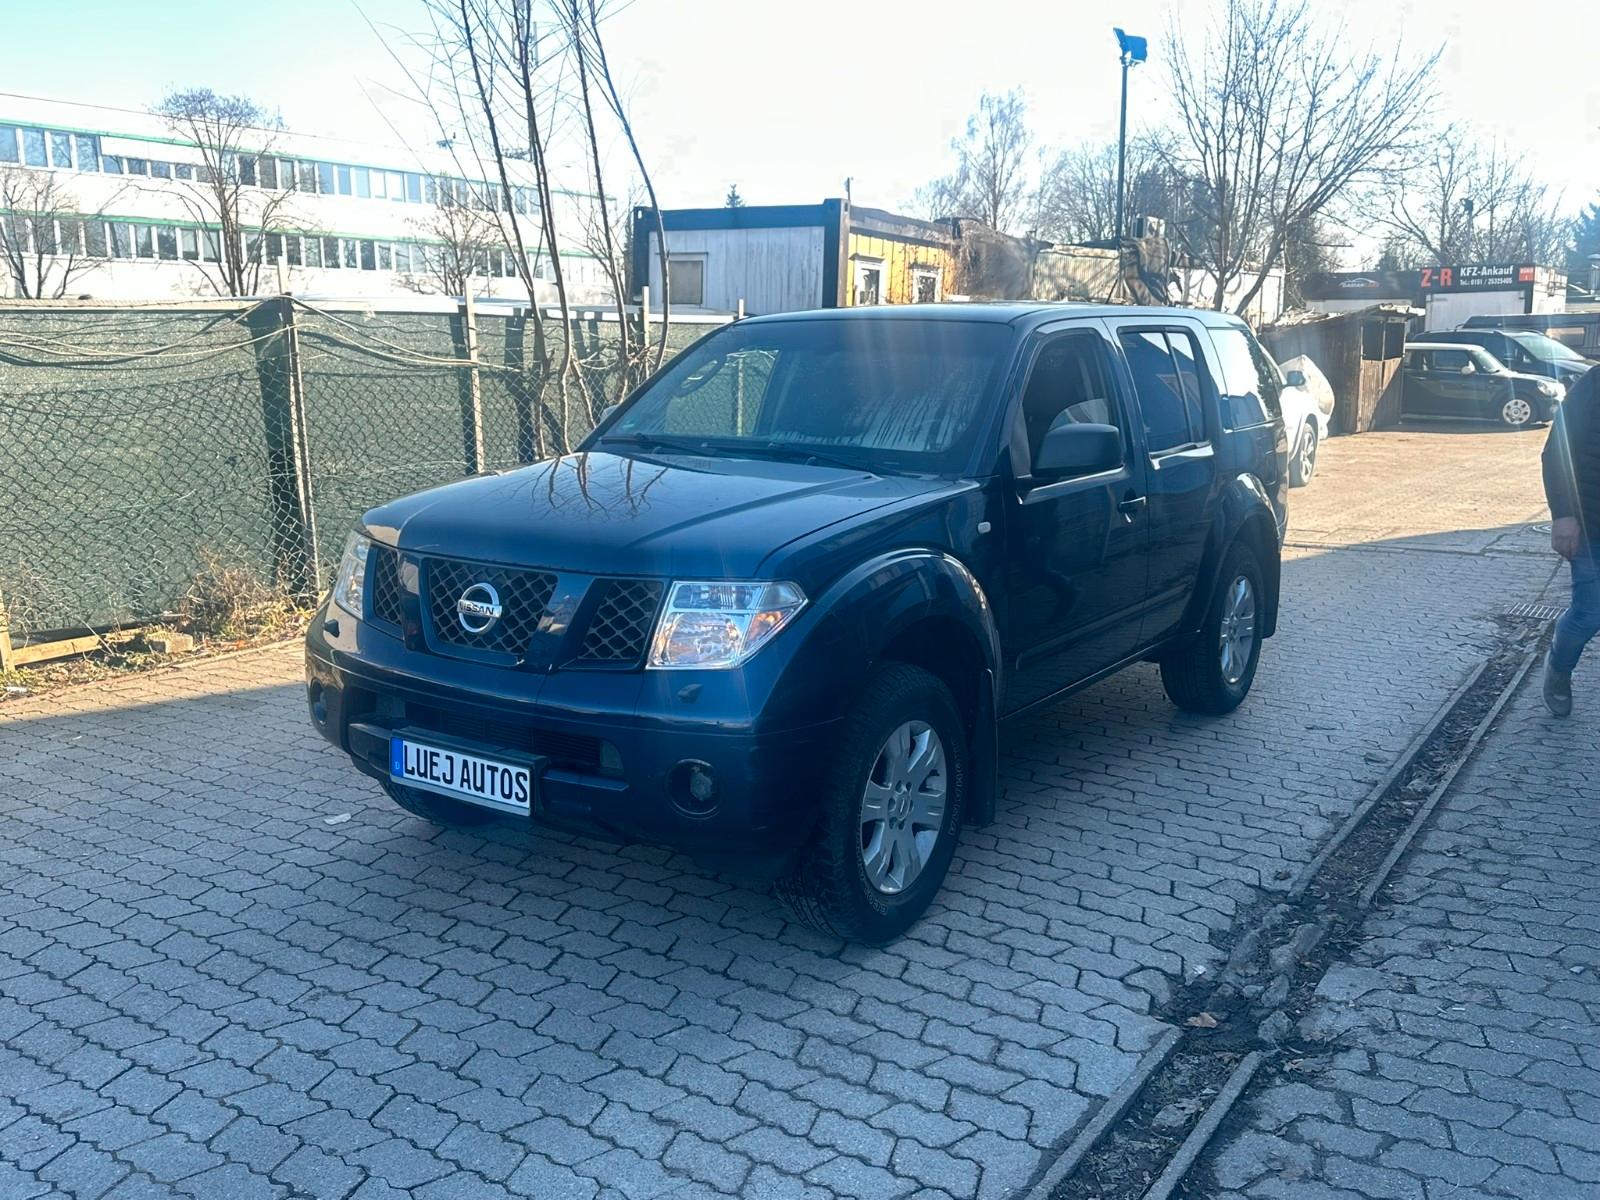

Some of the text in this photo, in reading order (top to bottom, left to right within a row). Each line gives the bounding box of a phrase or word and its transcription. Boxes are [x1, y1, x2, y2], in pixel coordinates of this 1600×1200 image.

[1421, 267, 1453, 288] Z-R
[1460, 265, 1514, 277] KFZ-Ankauf
[460, 602, 495, 615] NISSAN
[404, 745, 528, 803] LUEJ AUTOS
